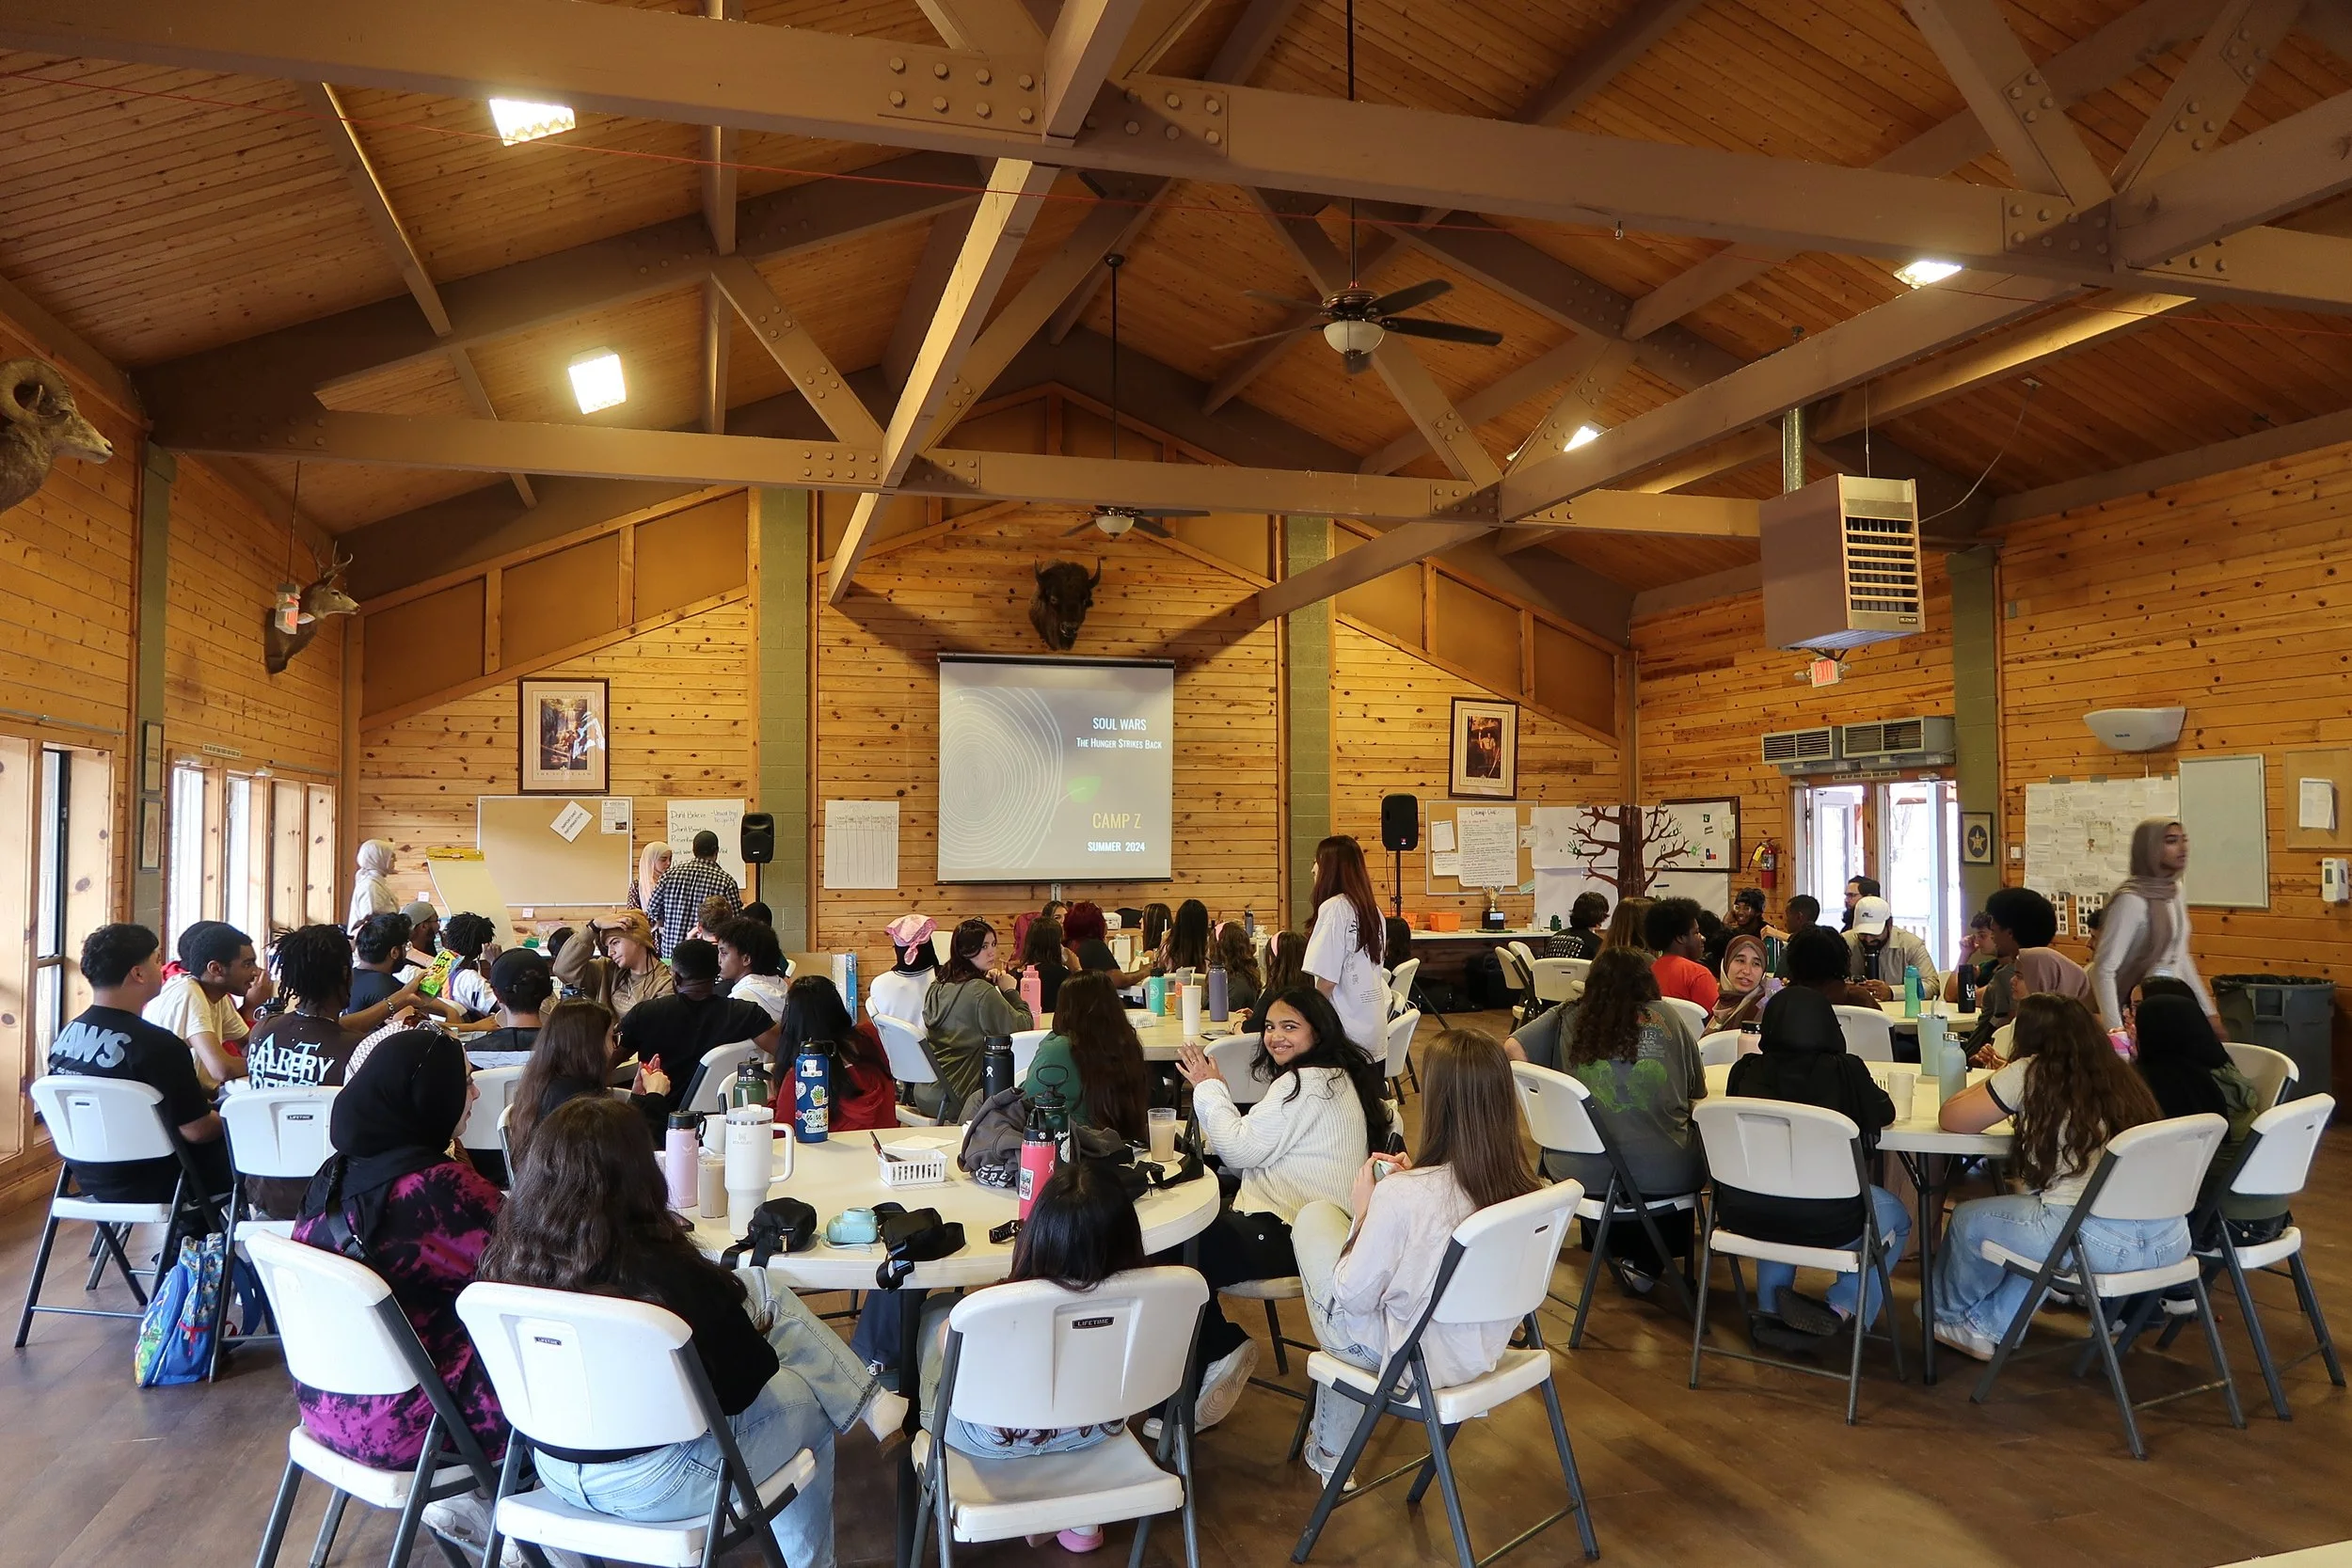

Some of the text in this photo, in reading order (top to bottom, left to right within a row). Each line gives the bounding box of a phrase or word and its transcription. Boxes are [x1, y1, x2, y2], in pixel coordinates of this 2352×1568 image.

[1814, 659, 1836, 684] EXIT
[1092, 717, 1147, 731] SOUL WARS
[1076, 736, 1163, 750] THE HUNGER STRIKES BACK
[1092, 813, 1142, 829] CAMP Z
[1088, 841, 1146, 852] SUMMER 2024
[1077, 1318, 1110, 1326] LIFETIME
